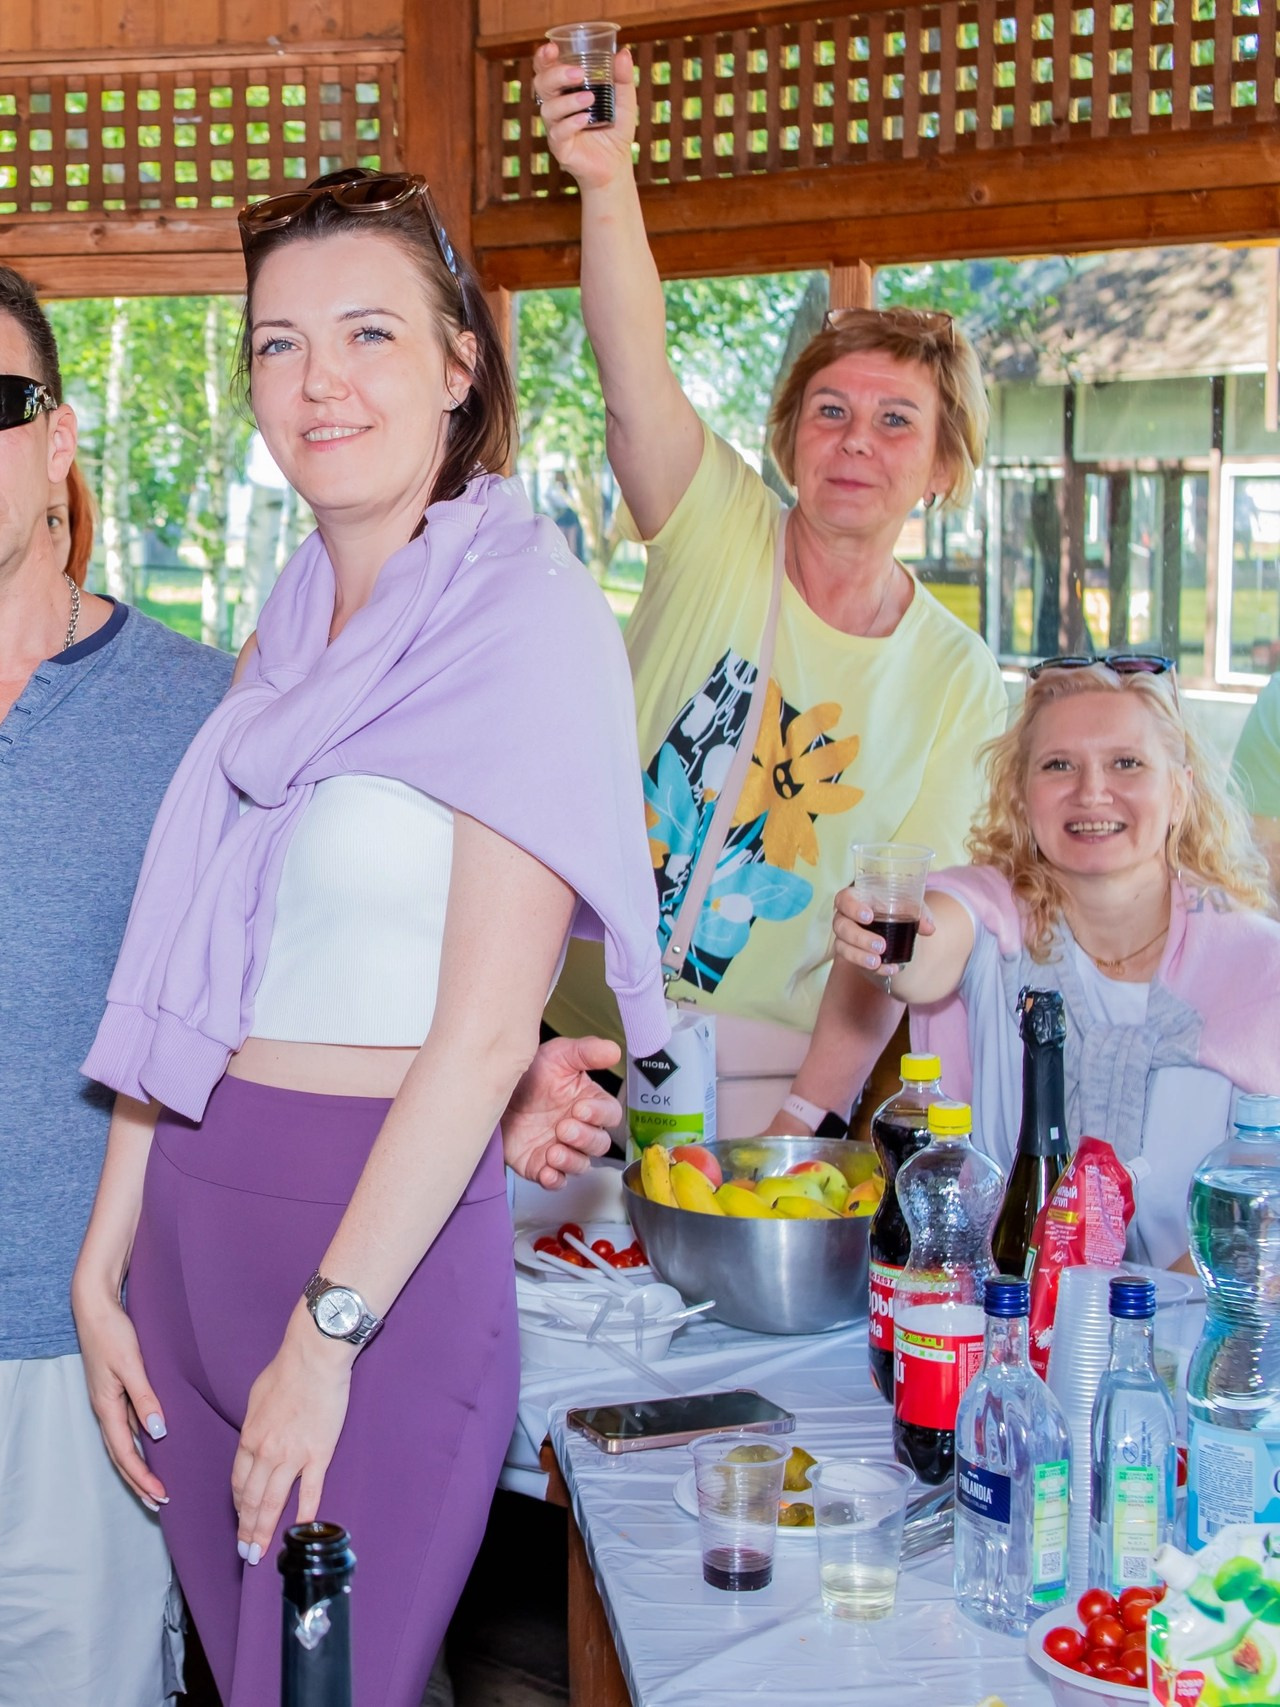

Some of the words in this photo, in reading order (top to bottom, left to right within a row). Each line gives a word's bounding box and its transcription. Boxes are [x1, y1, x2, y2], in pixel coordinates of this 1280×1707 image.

[641, 1060, 671, 1070] RIOBA
[640, 1093, 671, 1106] СОК
[959, 1472, 993, 1505] FINLANDIA
